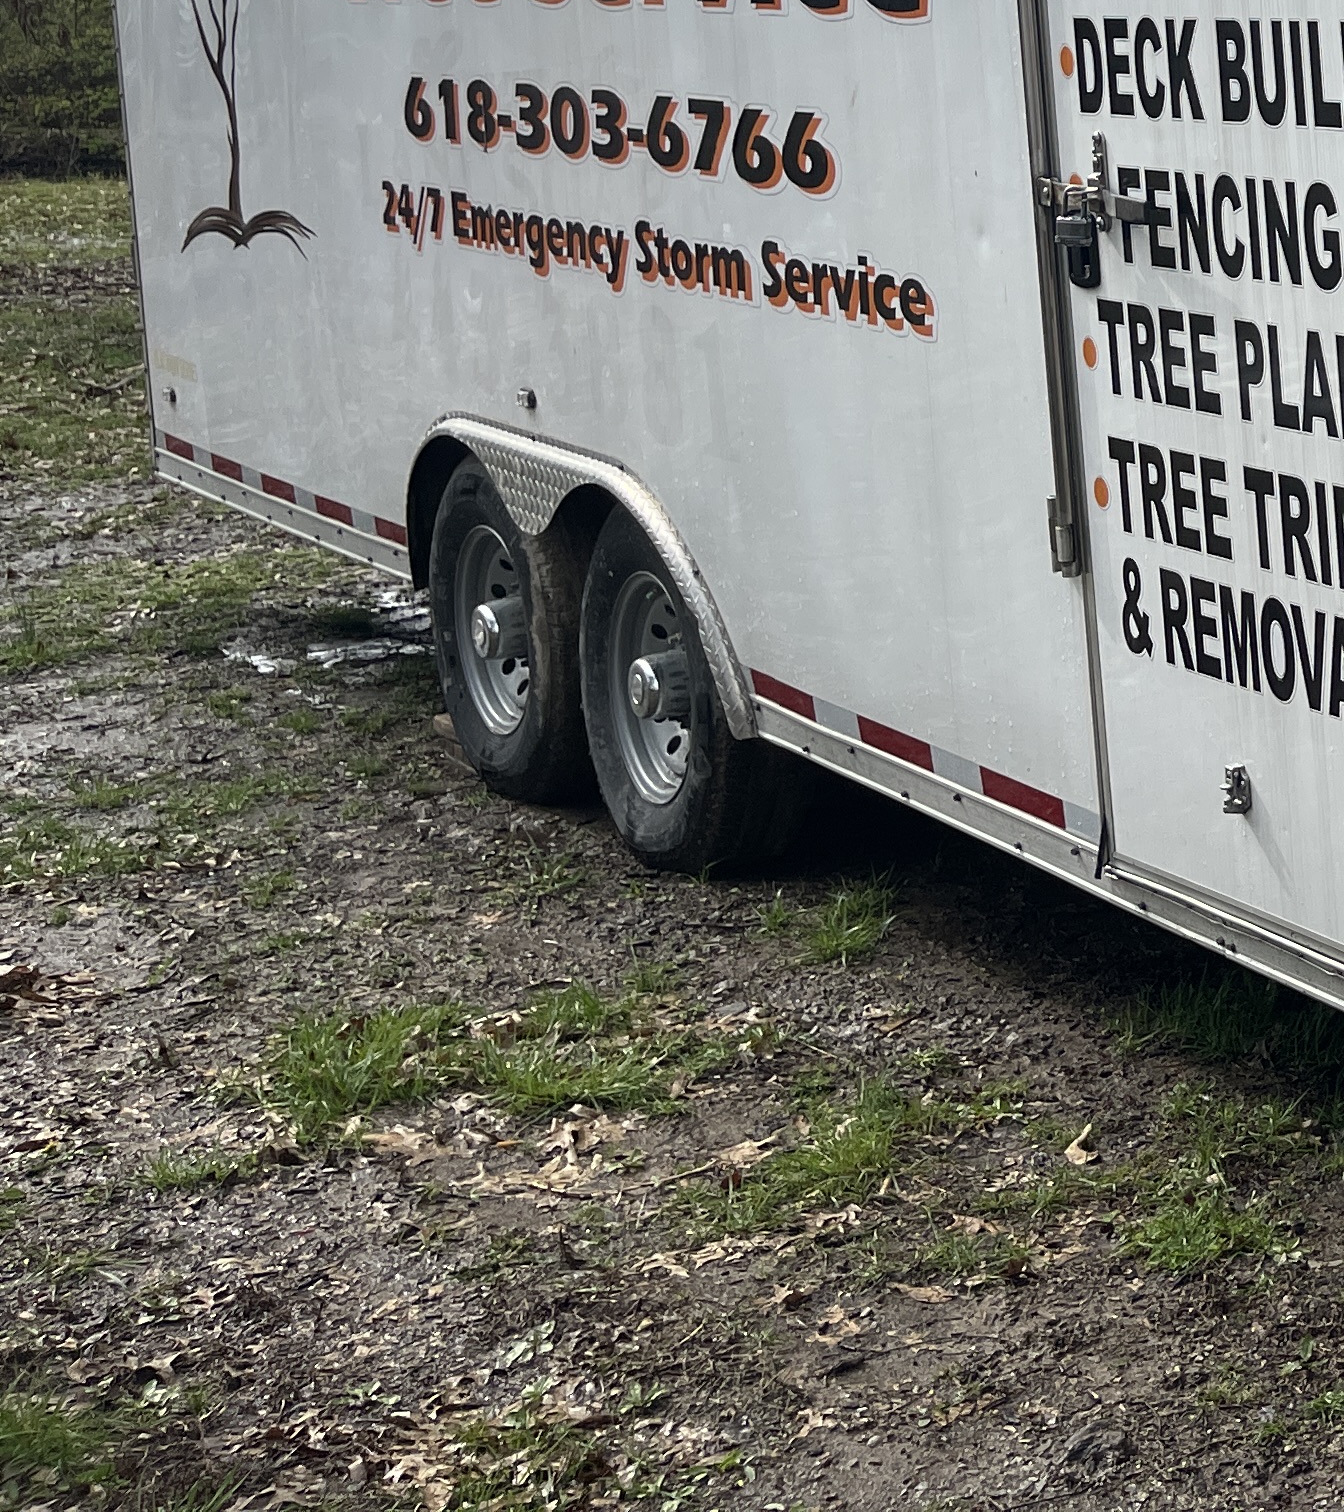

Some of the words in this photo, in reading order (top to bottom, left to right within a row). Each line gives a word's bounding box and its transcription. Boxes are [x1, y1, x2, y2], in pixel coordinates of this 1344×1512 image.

[1073, 18, 1205, 120] DECK
[404, 77, 834, 194] 618-303-6766
[382, 181, 443, 244] 24/7
[451, 191, 628, 291] Emergency
[635, 220, 752, 300] Storm
[762, 241, 933, 336] Service
[1118, 167, 1342, 290] FENCING
[1097, 298, 1222, 415] TREE
[1108, 436, 1232, 560] TREE
[1123, 558, 1153, 657] &
